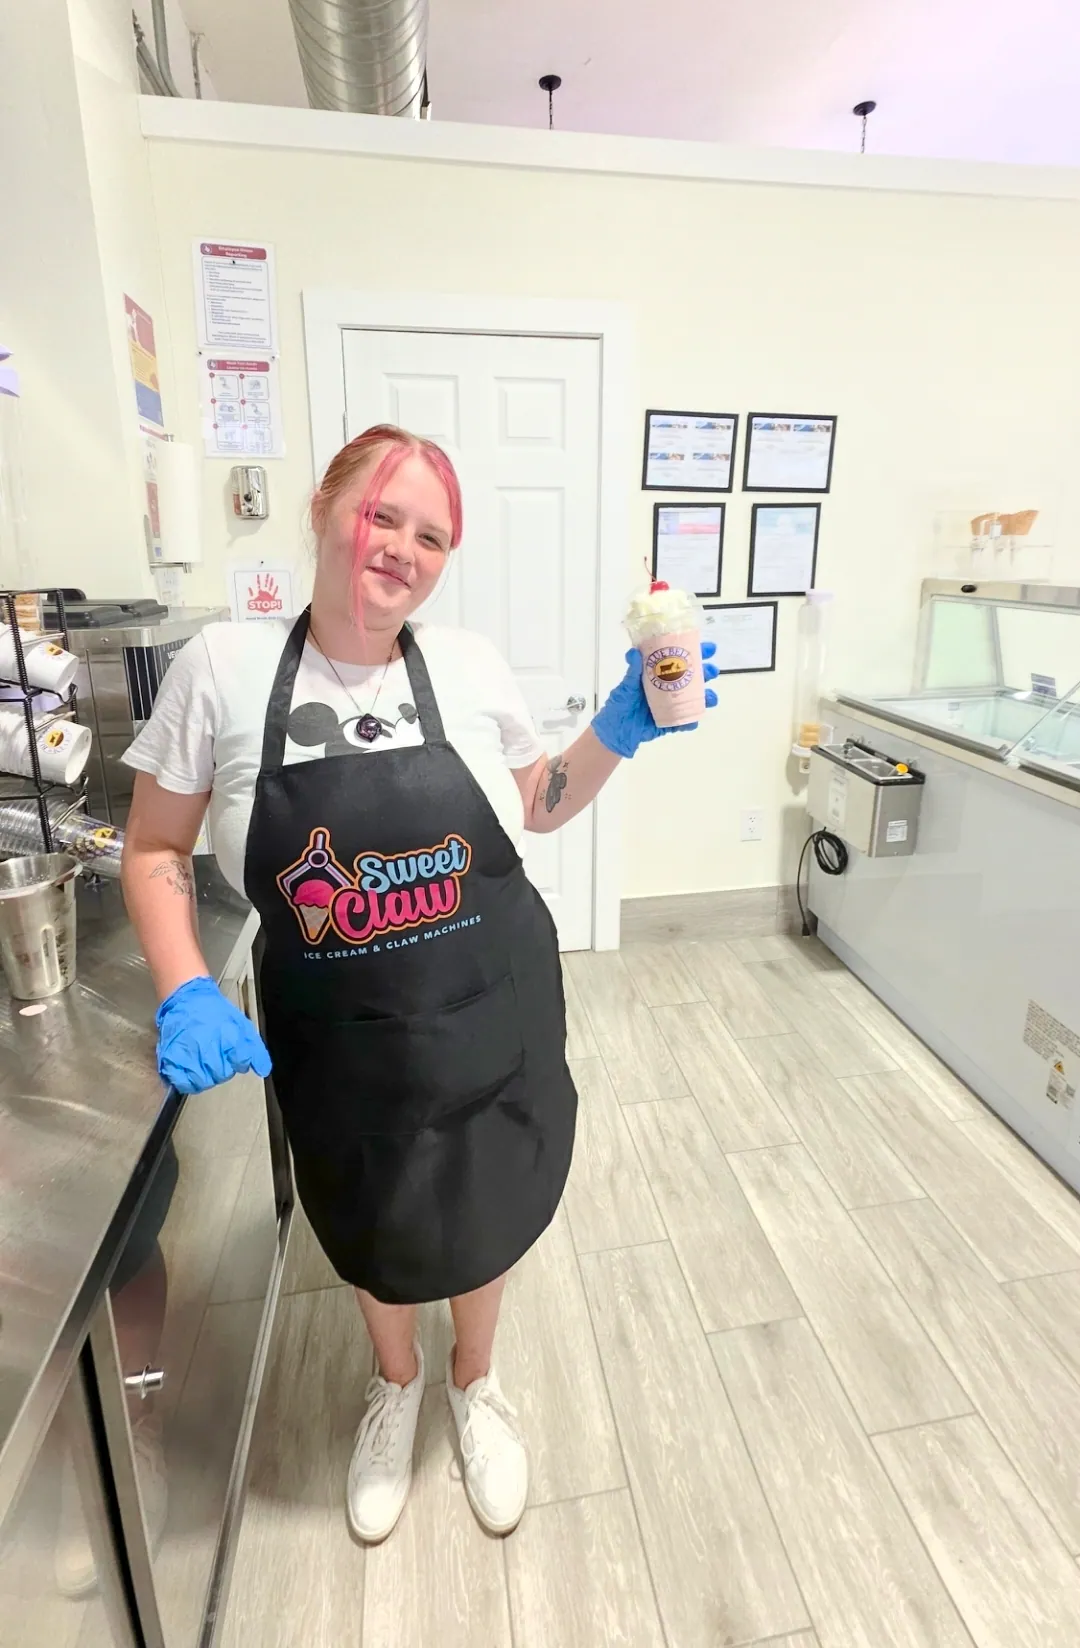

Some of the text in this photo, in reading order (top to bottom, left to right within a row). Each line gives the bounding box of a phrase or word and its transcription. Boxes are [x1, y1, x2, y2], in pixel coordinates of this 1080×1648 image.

[248, 600, 282, 610] STOP!
[167, 650, 176, 660] VE
[646, 650, 665, 668] BLUE
[360, 840, 466, 893] Sweet
[335, 878, 455, 939] Claw
[304, 914, 482, 960] ICE CREAM & CLAW MACHINES
